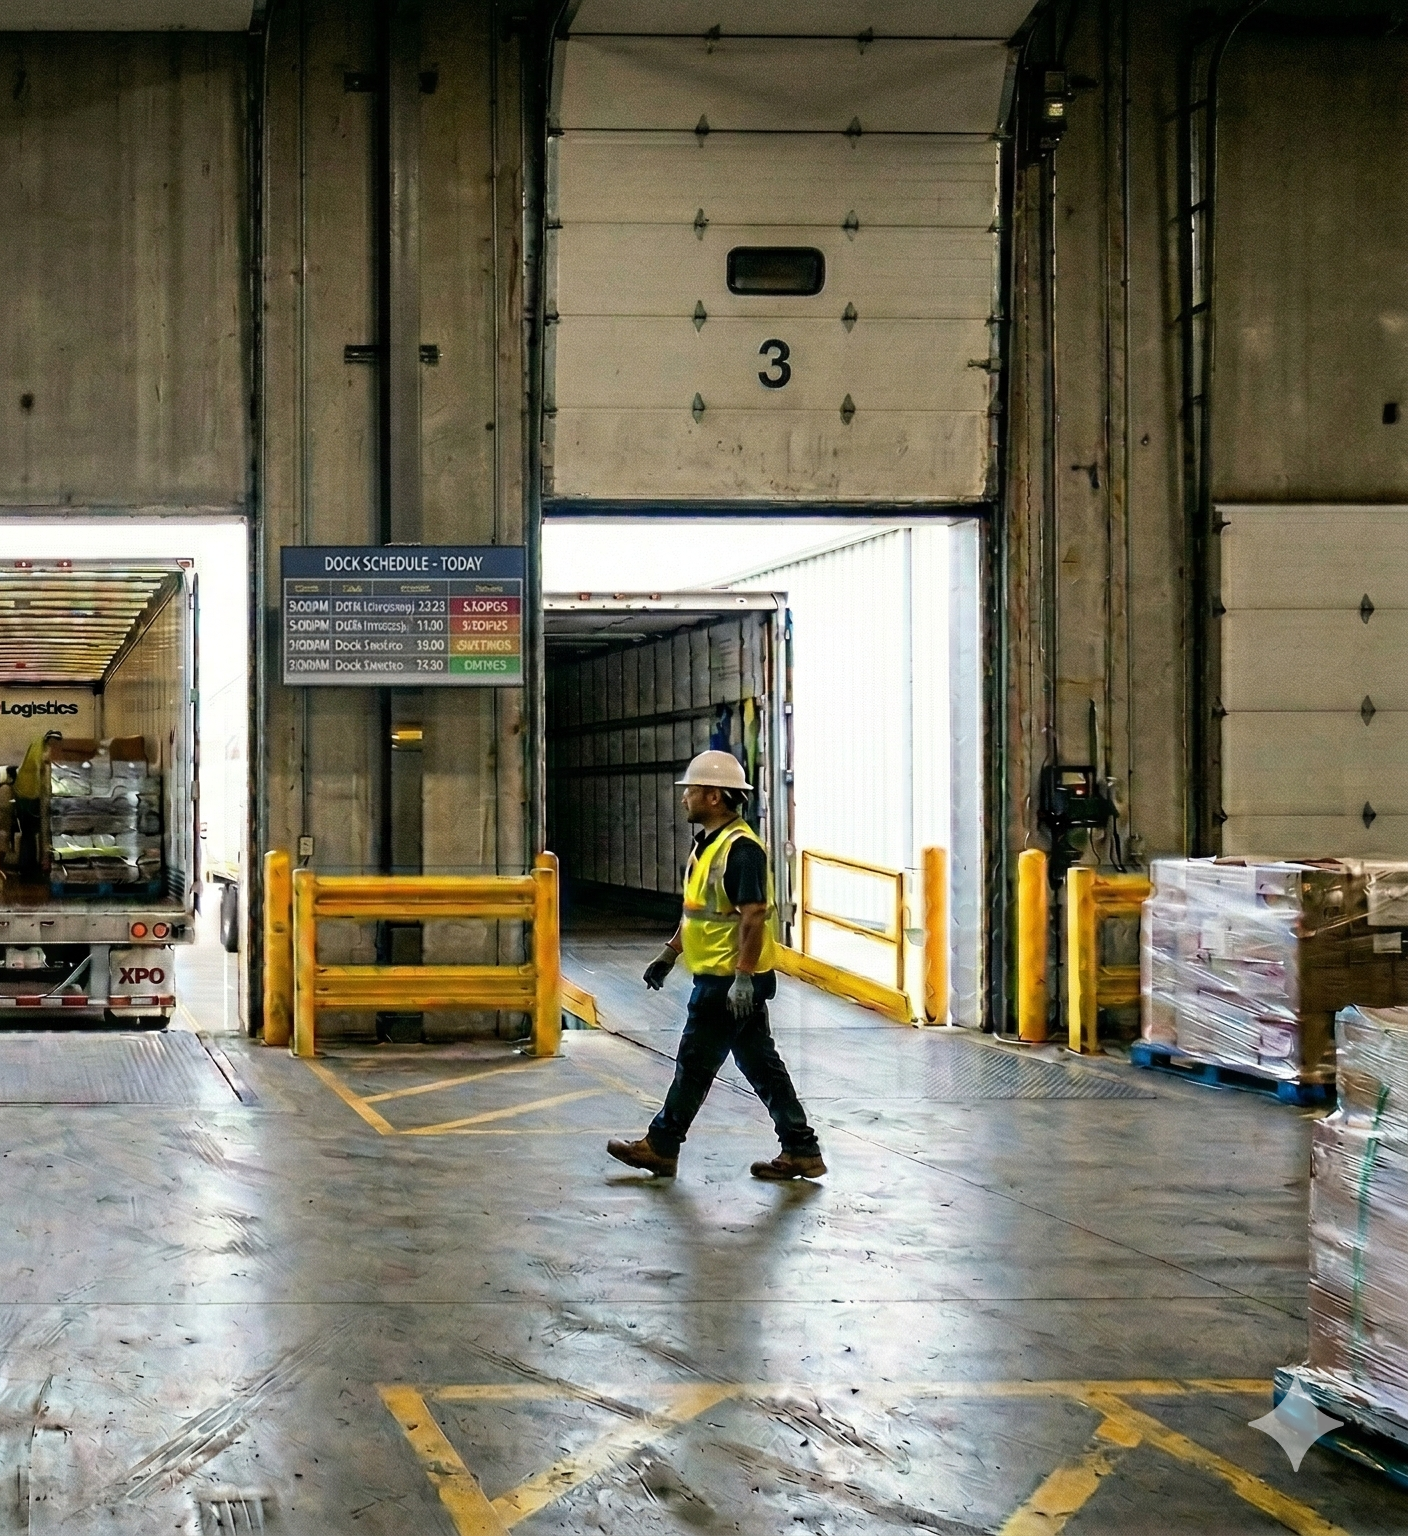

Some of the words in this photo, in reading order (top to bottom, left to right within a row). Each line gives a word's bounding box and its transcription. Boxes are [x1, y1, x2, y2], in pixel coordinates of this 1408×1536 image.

[758, 338, 792, 388] 3
[325, 557, 360, 571] DOCK
[363, 557, 429, 571] SCHEDULE
[441, 557, 483, 571] TODAY
[336, 640, 361, 650] Dock
[336, 659, 361, 670] Dock
[118, 968, 164, 984] XPO
